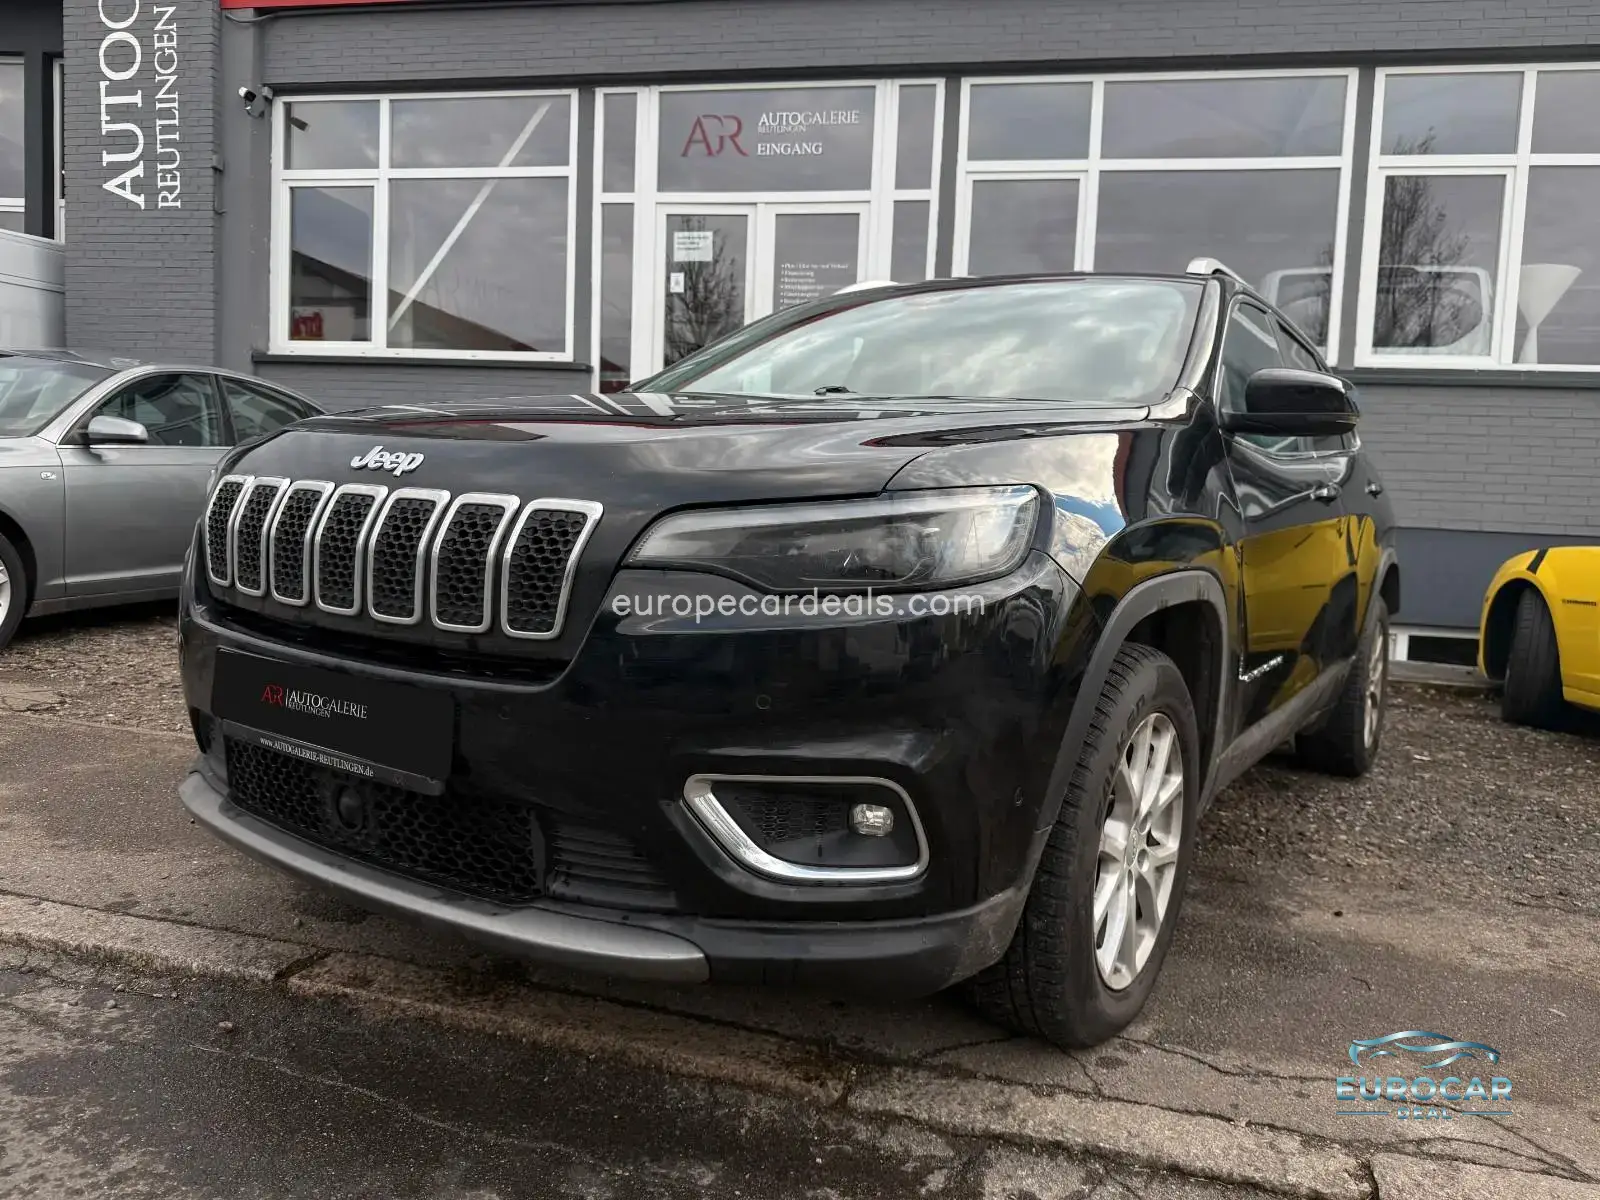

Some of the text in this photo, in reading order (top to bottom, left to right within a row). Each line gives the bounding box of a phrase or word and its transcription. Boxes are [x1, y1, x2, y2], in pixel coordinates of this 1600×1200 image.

[153, 5, 181, 209] REUTLINGEN
[758, 110, 860, 126] AUTOGALERIE
[757, 142, 823, 156] EINGANG
[350, 445, 425, 477] Jeep
[288, 701, 331, 719] REUTLINGEN
[289, 690, 368, 719] AUTOGALERIE
